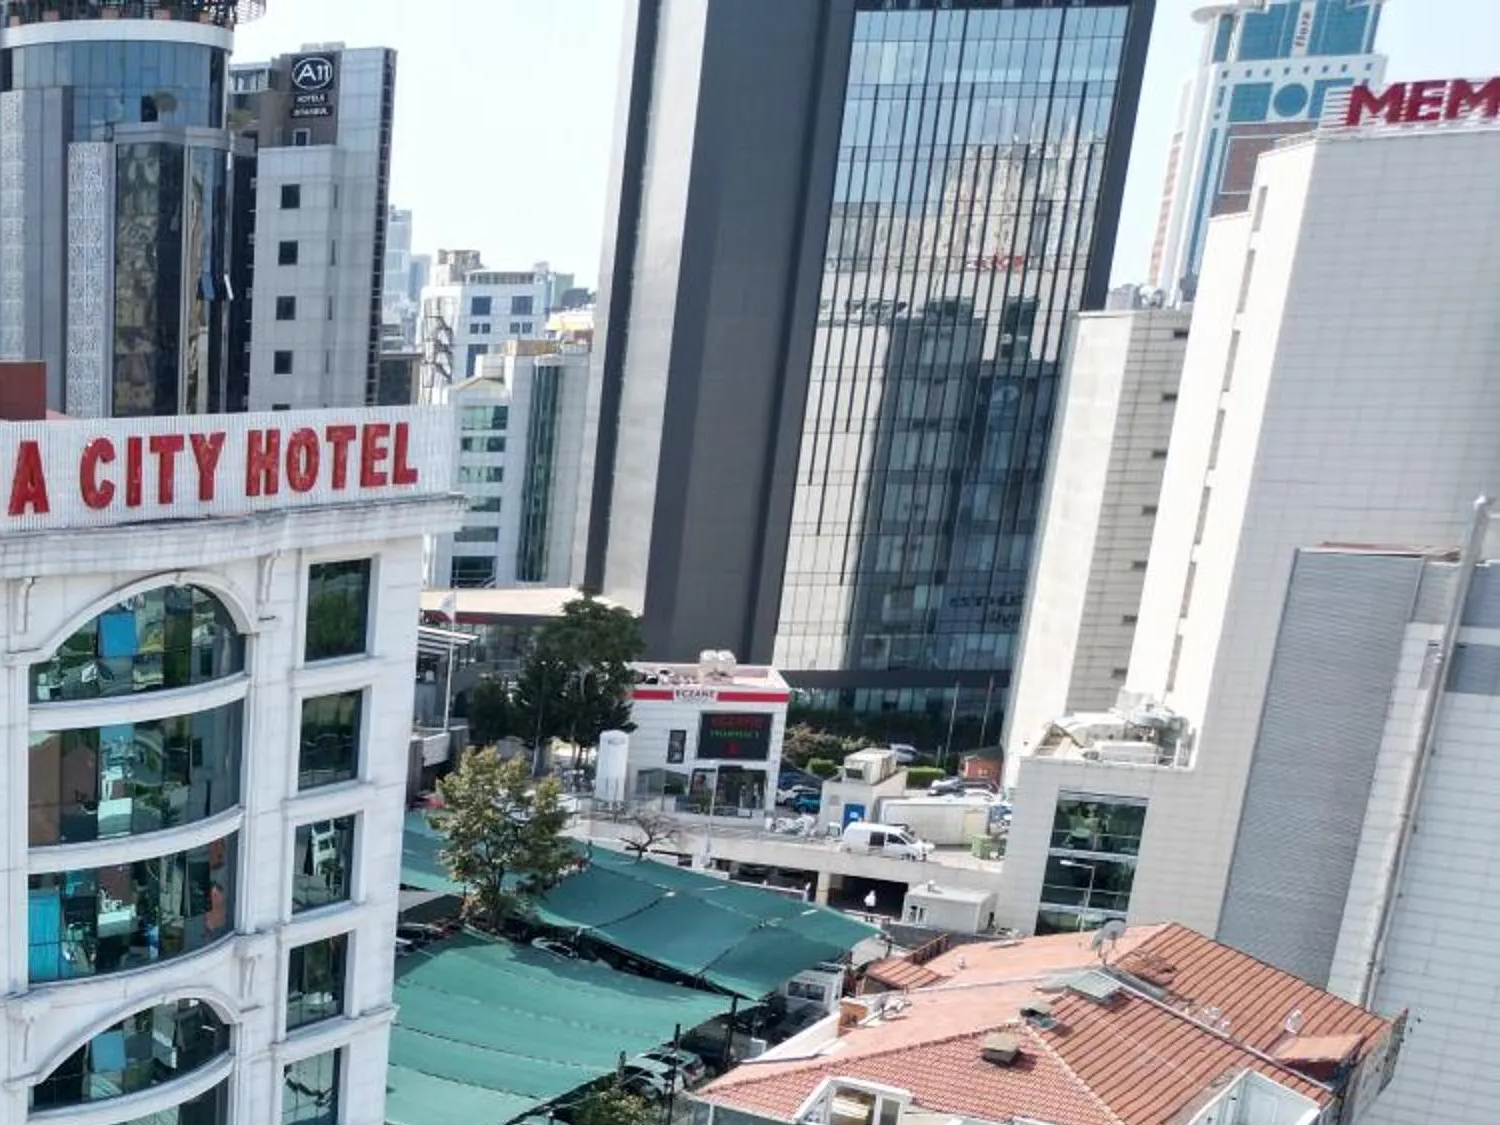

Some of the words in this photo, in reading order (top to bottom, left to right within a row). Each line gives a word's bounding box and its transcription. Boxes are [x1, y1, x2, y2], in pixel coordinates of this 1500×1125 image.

[1346, 77, 1500, 126] MEM
[79, 432, 226, 510] CITY
[245, 421, 418, 498] HOTEL
[675, 689, 715, 699] ECZANE
